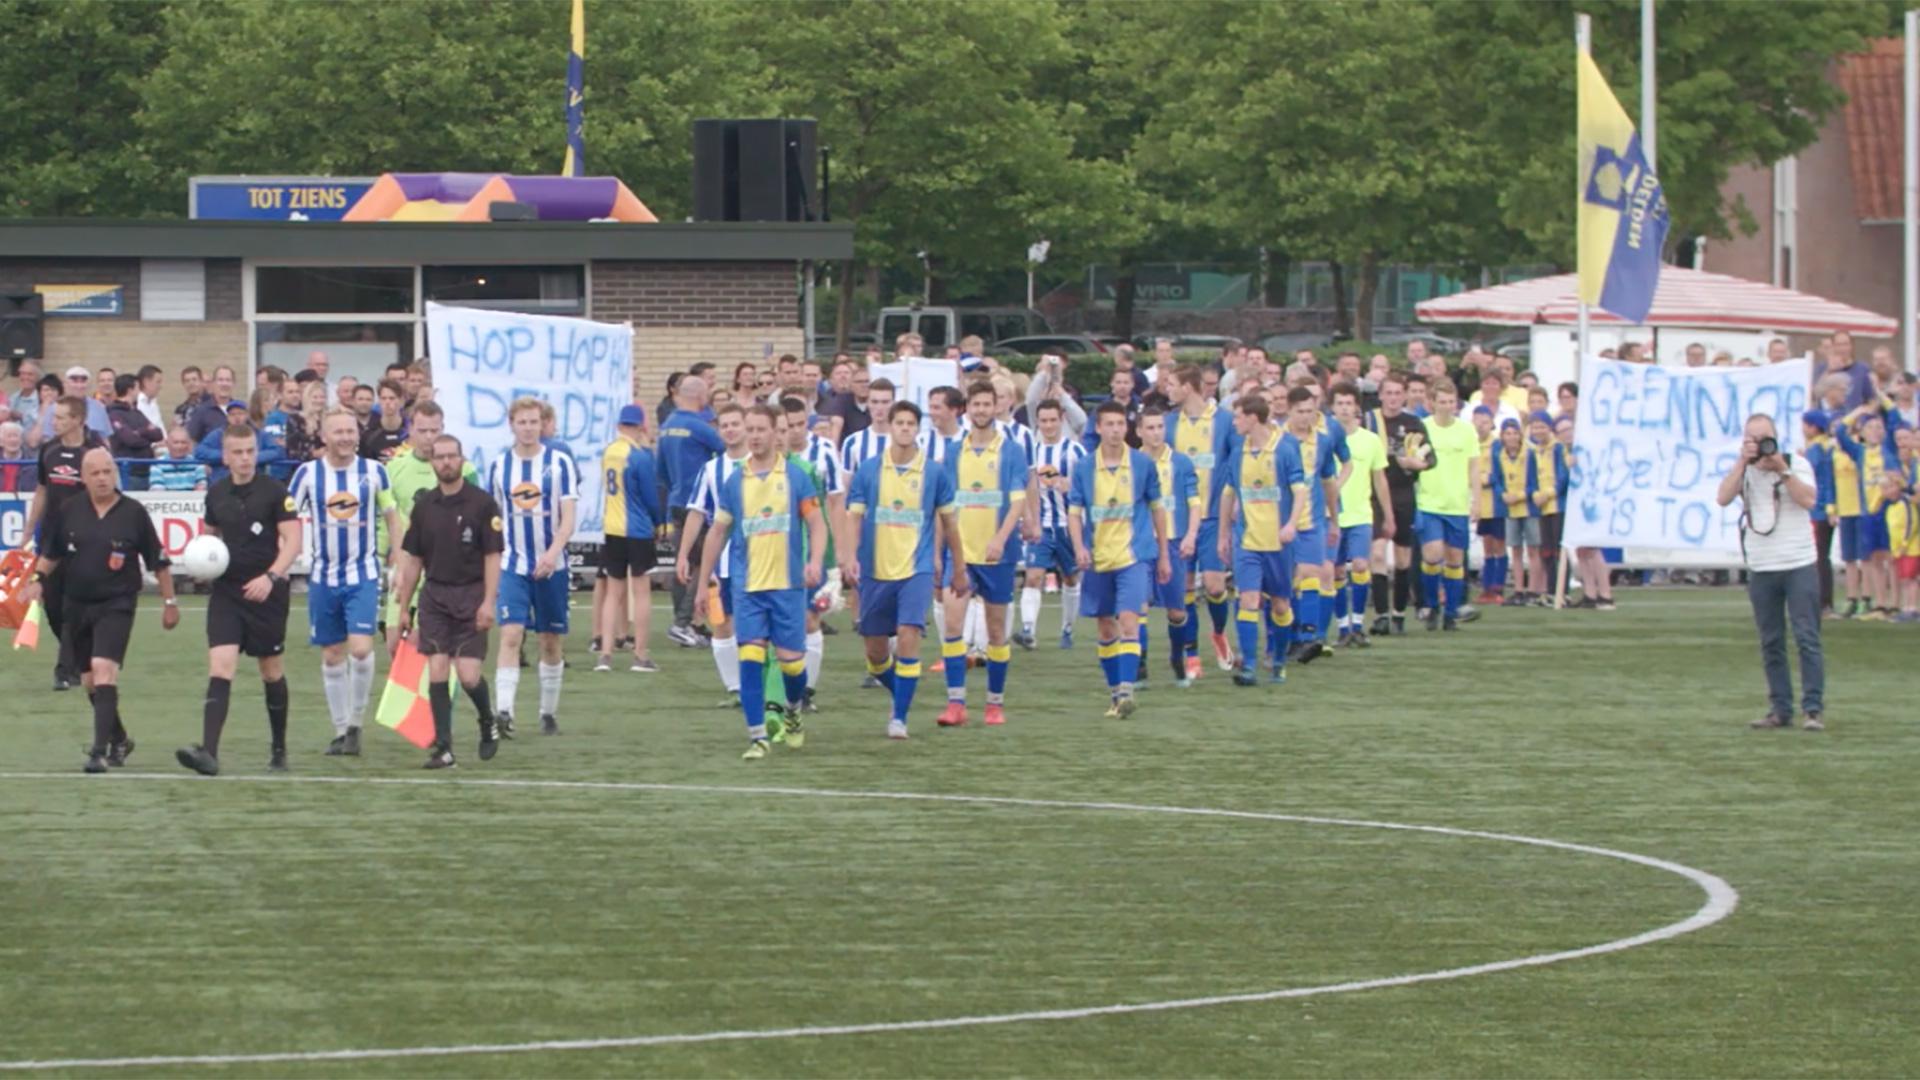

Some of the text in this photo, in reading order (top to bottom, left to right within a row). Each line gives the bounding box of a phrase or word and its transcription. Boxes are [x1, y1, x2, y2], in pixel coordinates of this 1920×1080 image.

[248, 188, 346, 208] TOT ZIENS
[448, 324, 534, 374] HOP
[548, 325, 608, 383] HOP
[606, 468, 618, 495] 8
[147, 502, 205, 513] SPECIALI
